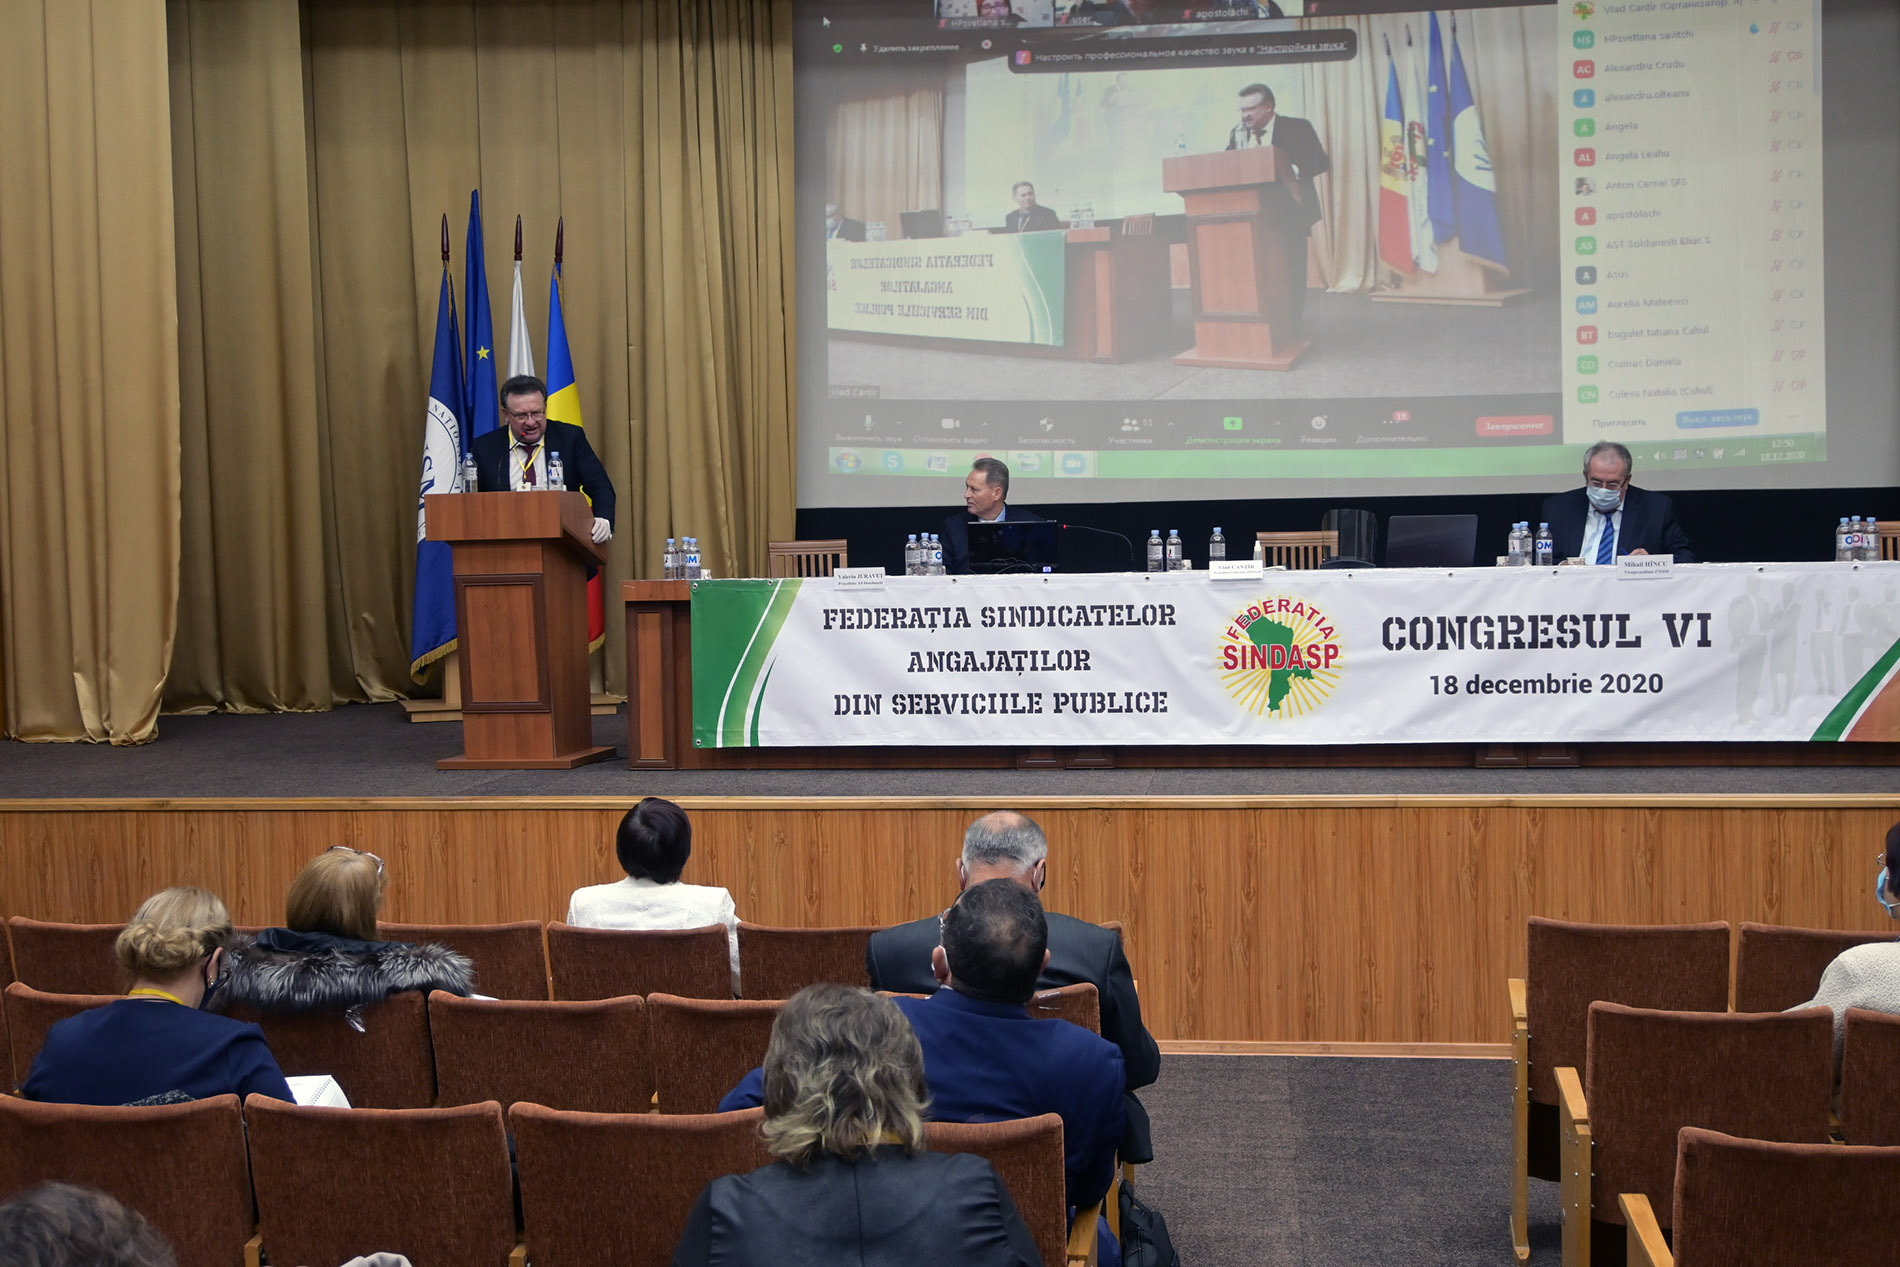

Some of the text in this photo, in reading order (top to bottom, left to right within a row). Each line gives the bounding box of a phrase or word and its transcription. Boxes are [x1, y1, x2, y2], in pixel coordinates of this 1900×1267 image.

[1035, 52, 1083, 62] Настроить
[1085, 49, 1176, 62] профессиональное
[1178, 47, 1219, 57] качество
[1222, 45, 1247, 56] звука
[1577, 64, 1591, 74] AC
[1604, 121, 1639, 133] Angela
[1578, 153, 1592, 163] AL
[1578, 300, 1595, 310] AM
[1581, 330, 1594, 340] BT
[823, 603, 1176, 634] FEDERAȚIA SINDICATELOR
[1226, 598, 1335, 640] FEDERATIA
[1382, 612, 1712, 651] CONGRESUL VI
[907, 649, 1091, 677] ANGAJAȚILOR
[1223, 644, 1339, 670] SINDASP
[1430, 672, 1664, 695] 18 decembrie 2020
[834, 691, 1168, 716] DIN SERVICIILE PUBLICE
